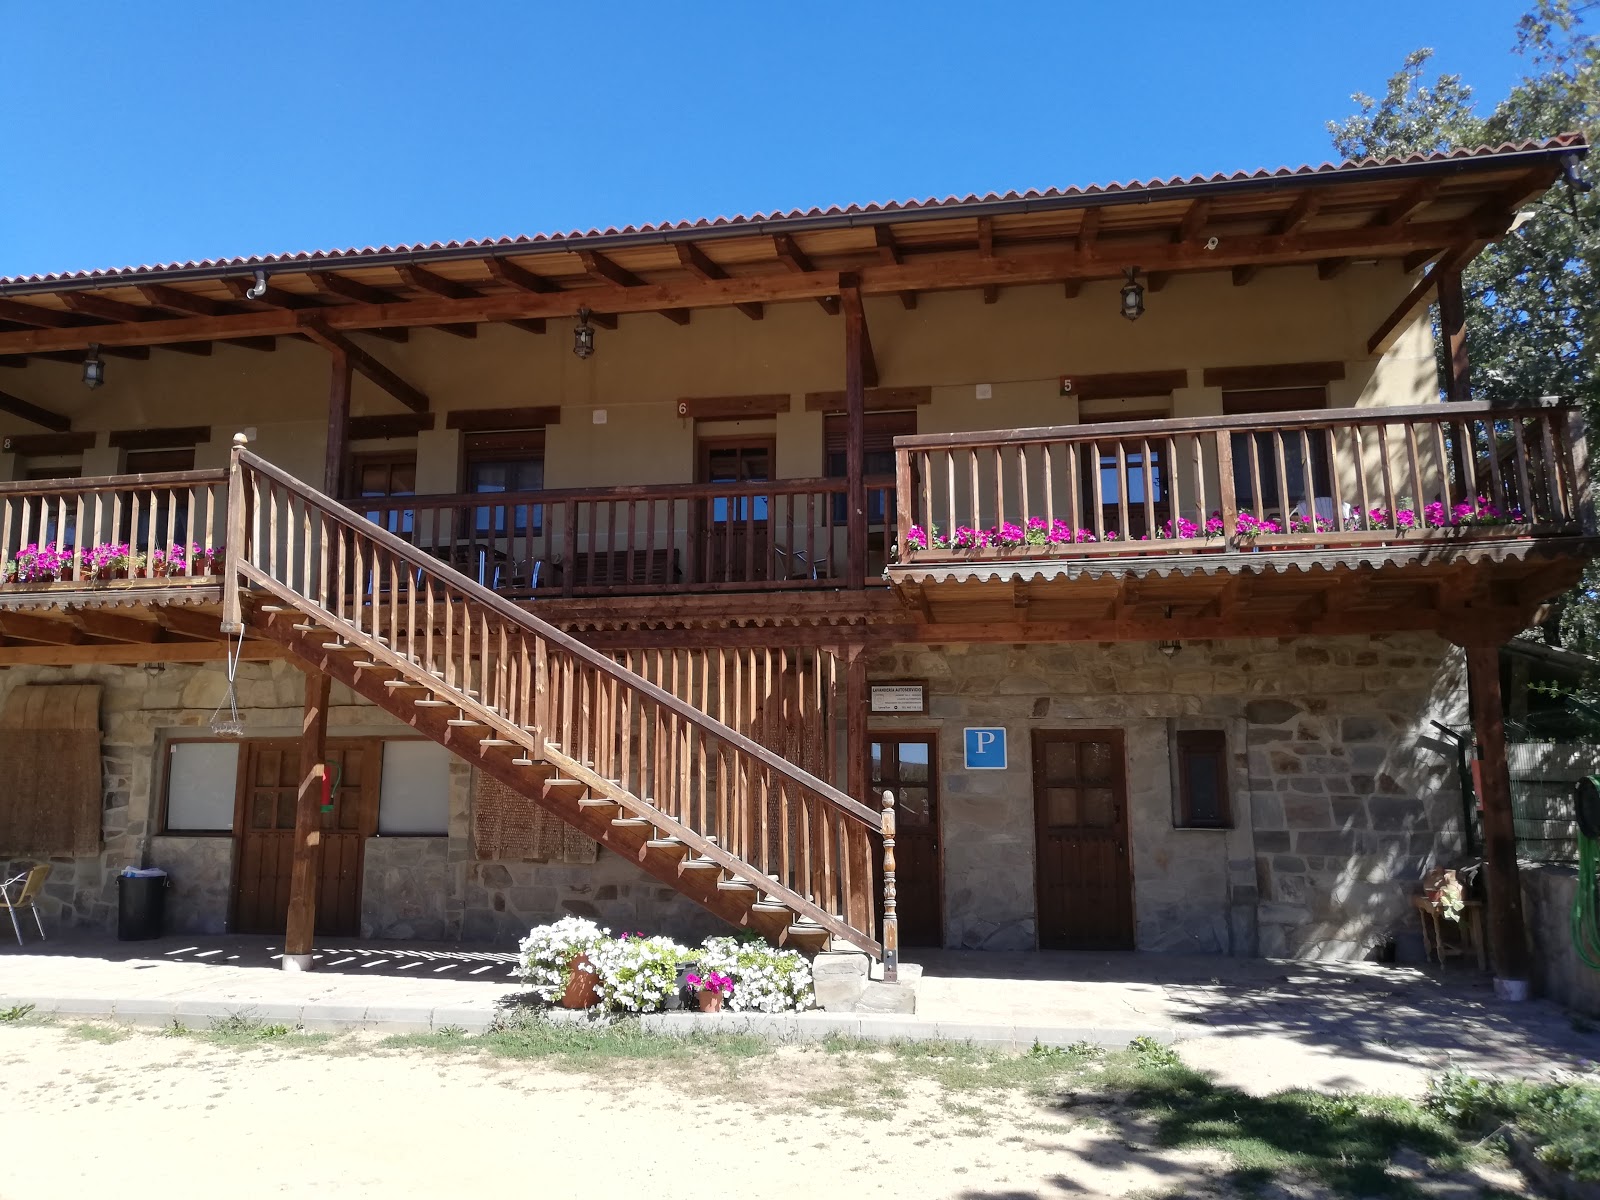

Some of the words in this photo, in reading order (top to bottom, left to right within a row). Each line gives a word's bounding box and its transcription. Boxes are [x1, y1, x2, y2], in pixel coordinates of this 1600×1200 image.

[1065, 380, 1071, 391] 5
[679, 403, 686, 414] 6
[4, 439, 10, 448] 8
[975, 732, 995, 753] P
